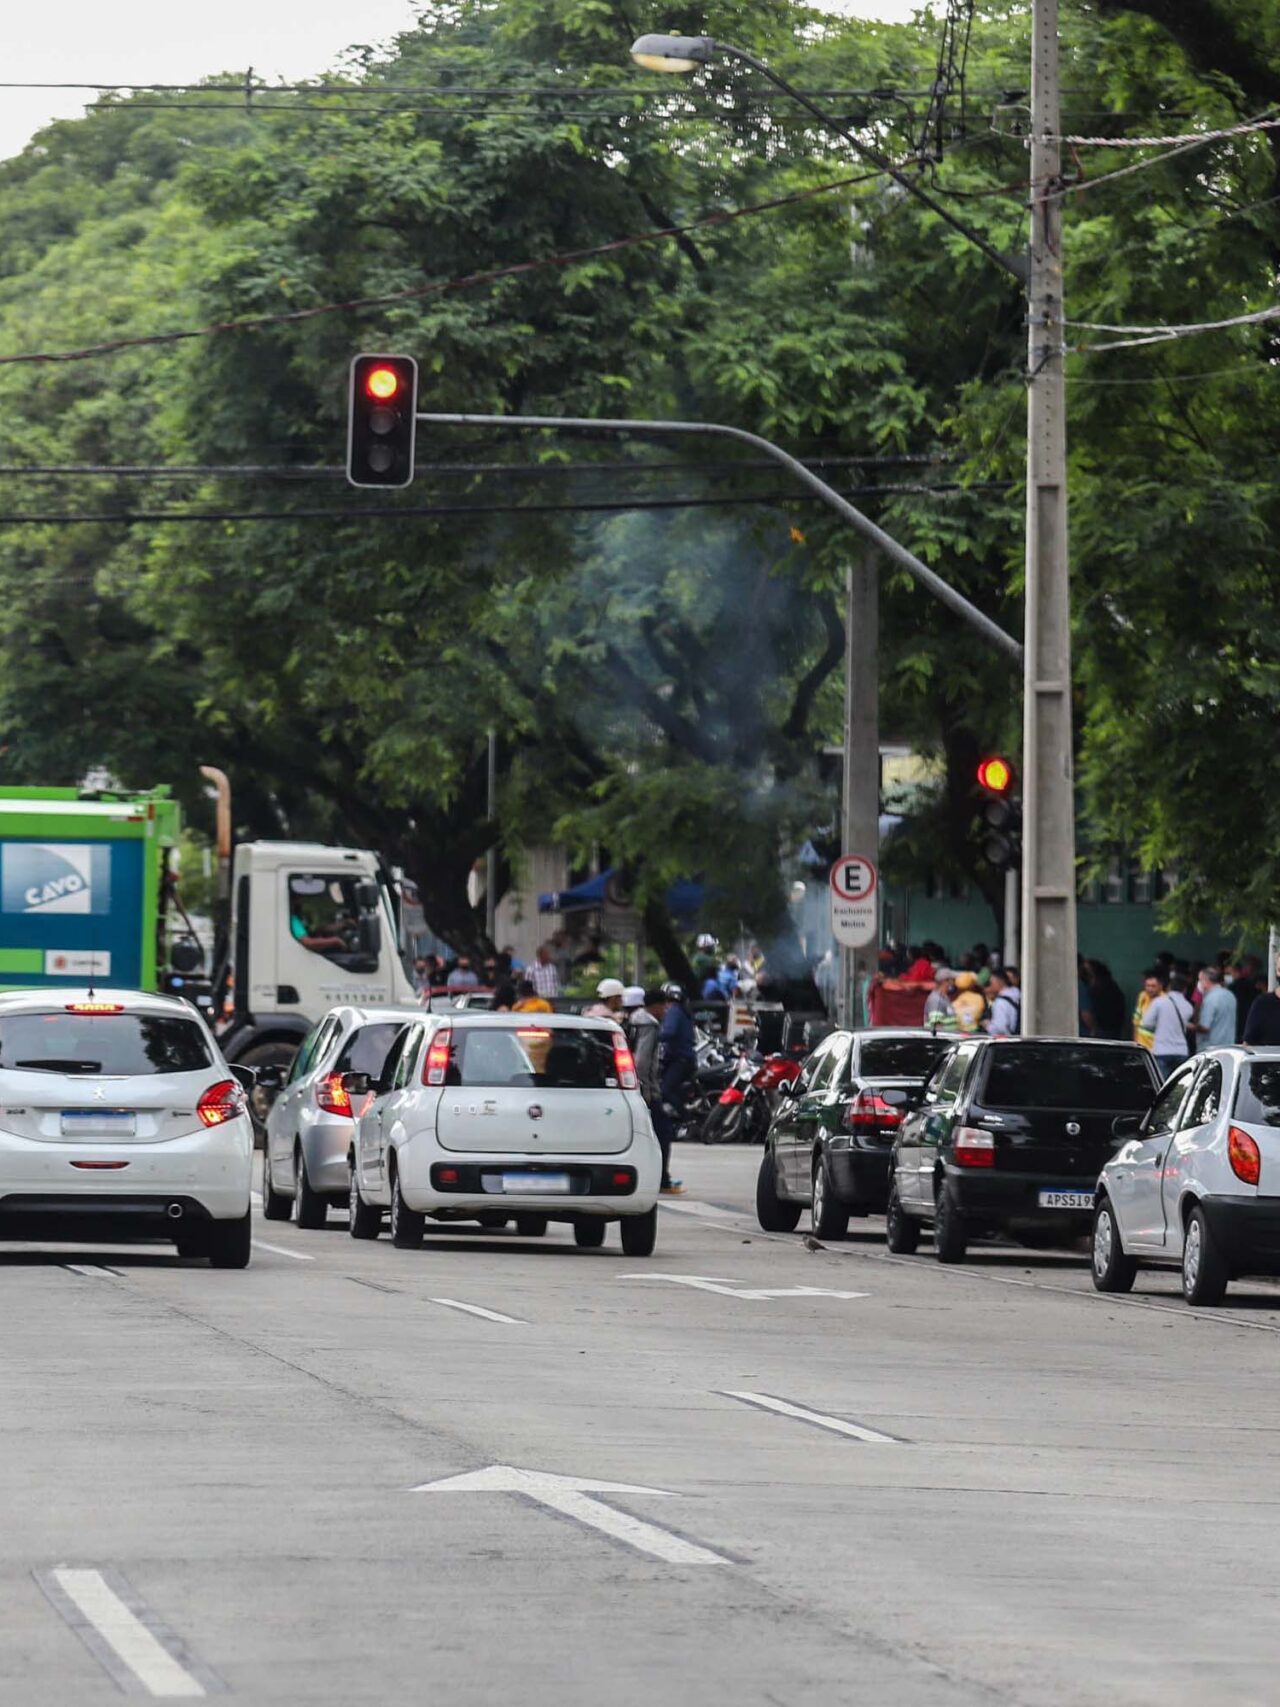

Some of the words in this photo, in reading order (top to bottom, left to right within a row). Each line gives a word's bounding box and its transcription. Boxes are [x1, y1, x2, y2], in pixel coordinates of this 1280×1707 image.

[24, 874, 83, 905] CAVO
[845, 865, 862, 891] E
[840, 920, 866, 929] Motos
